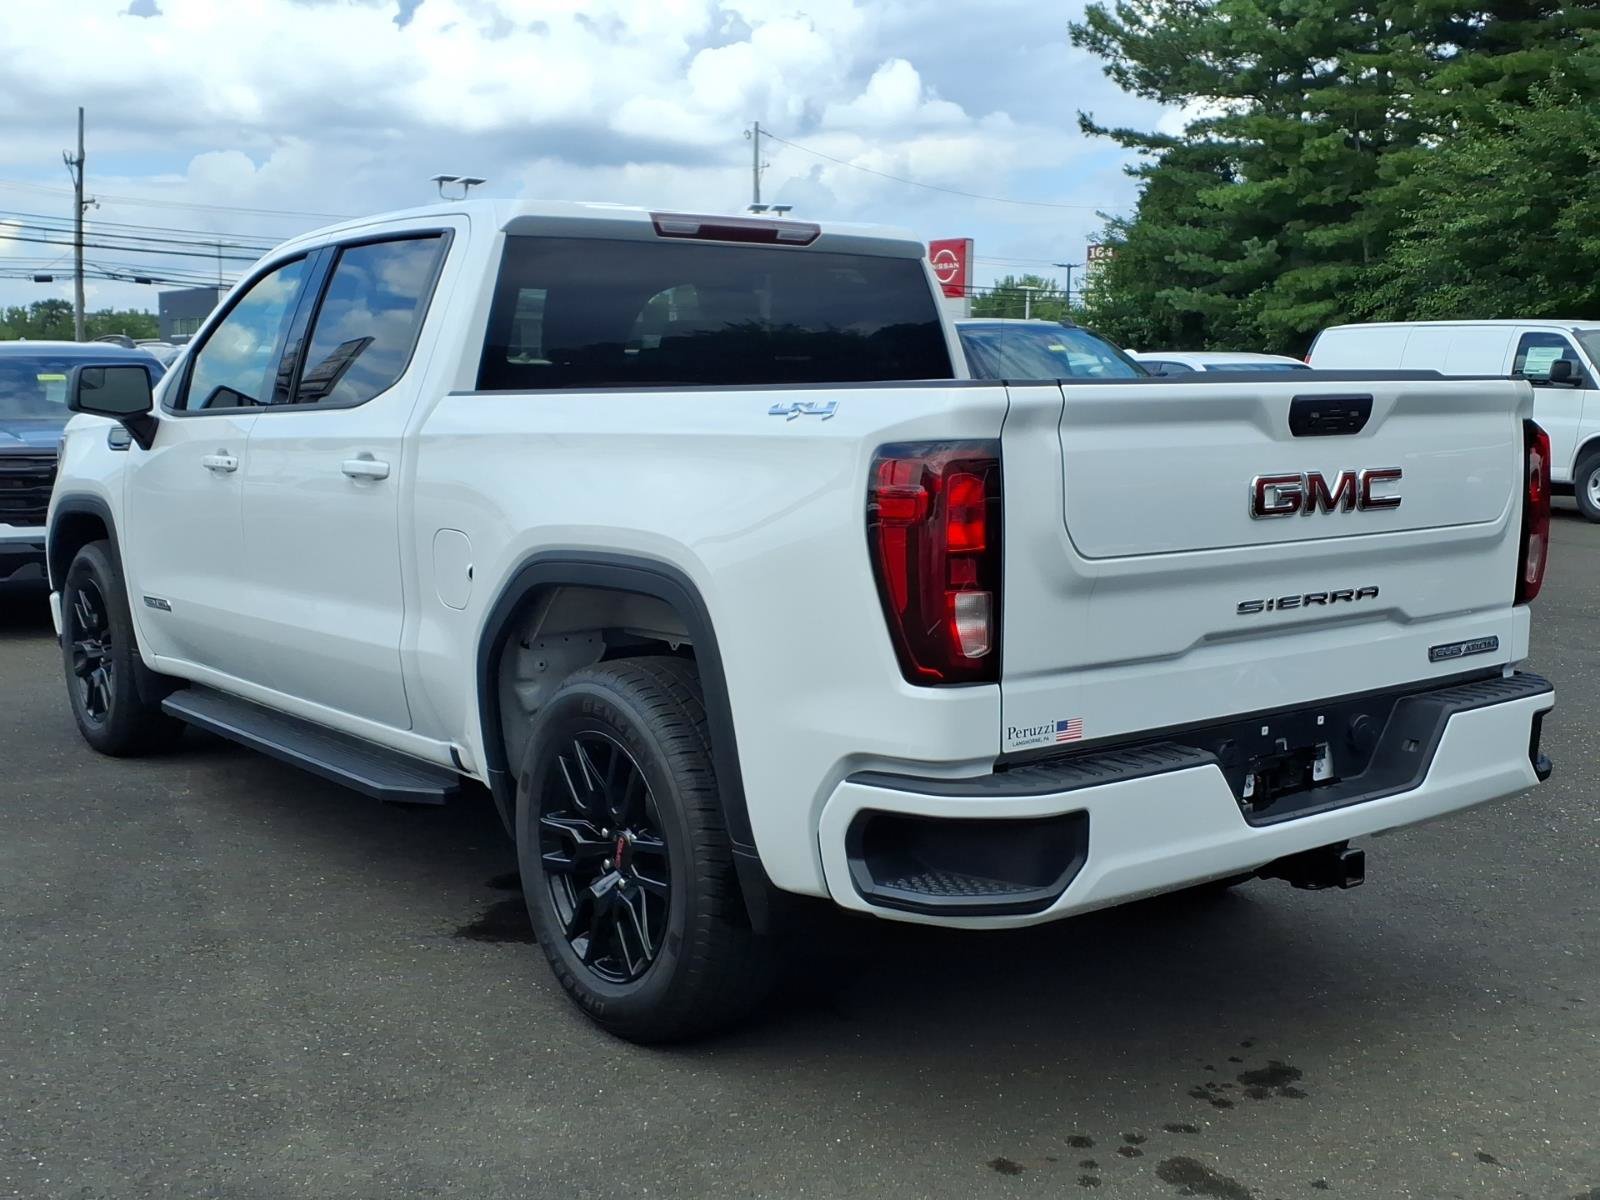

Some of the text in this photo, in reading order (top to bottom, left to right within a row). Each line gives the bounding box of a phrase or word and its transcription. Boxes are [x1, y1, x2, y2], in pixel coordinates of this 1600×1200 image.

[1249, 467, 1402, 520] GMC
[1236, 586, 1380, 615] SIERRA
[1007, 720, 1055, 740] Peruzzi
